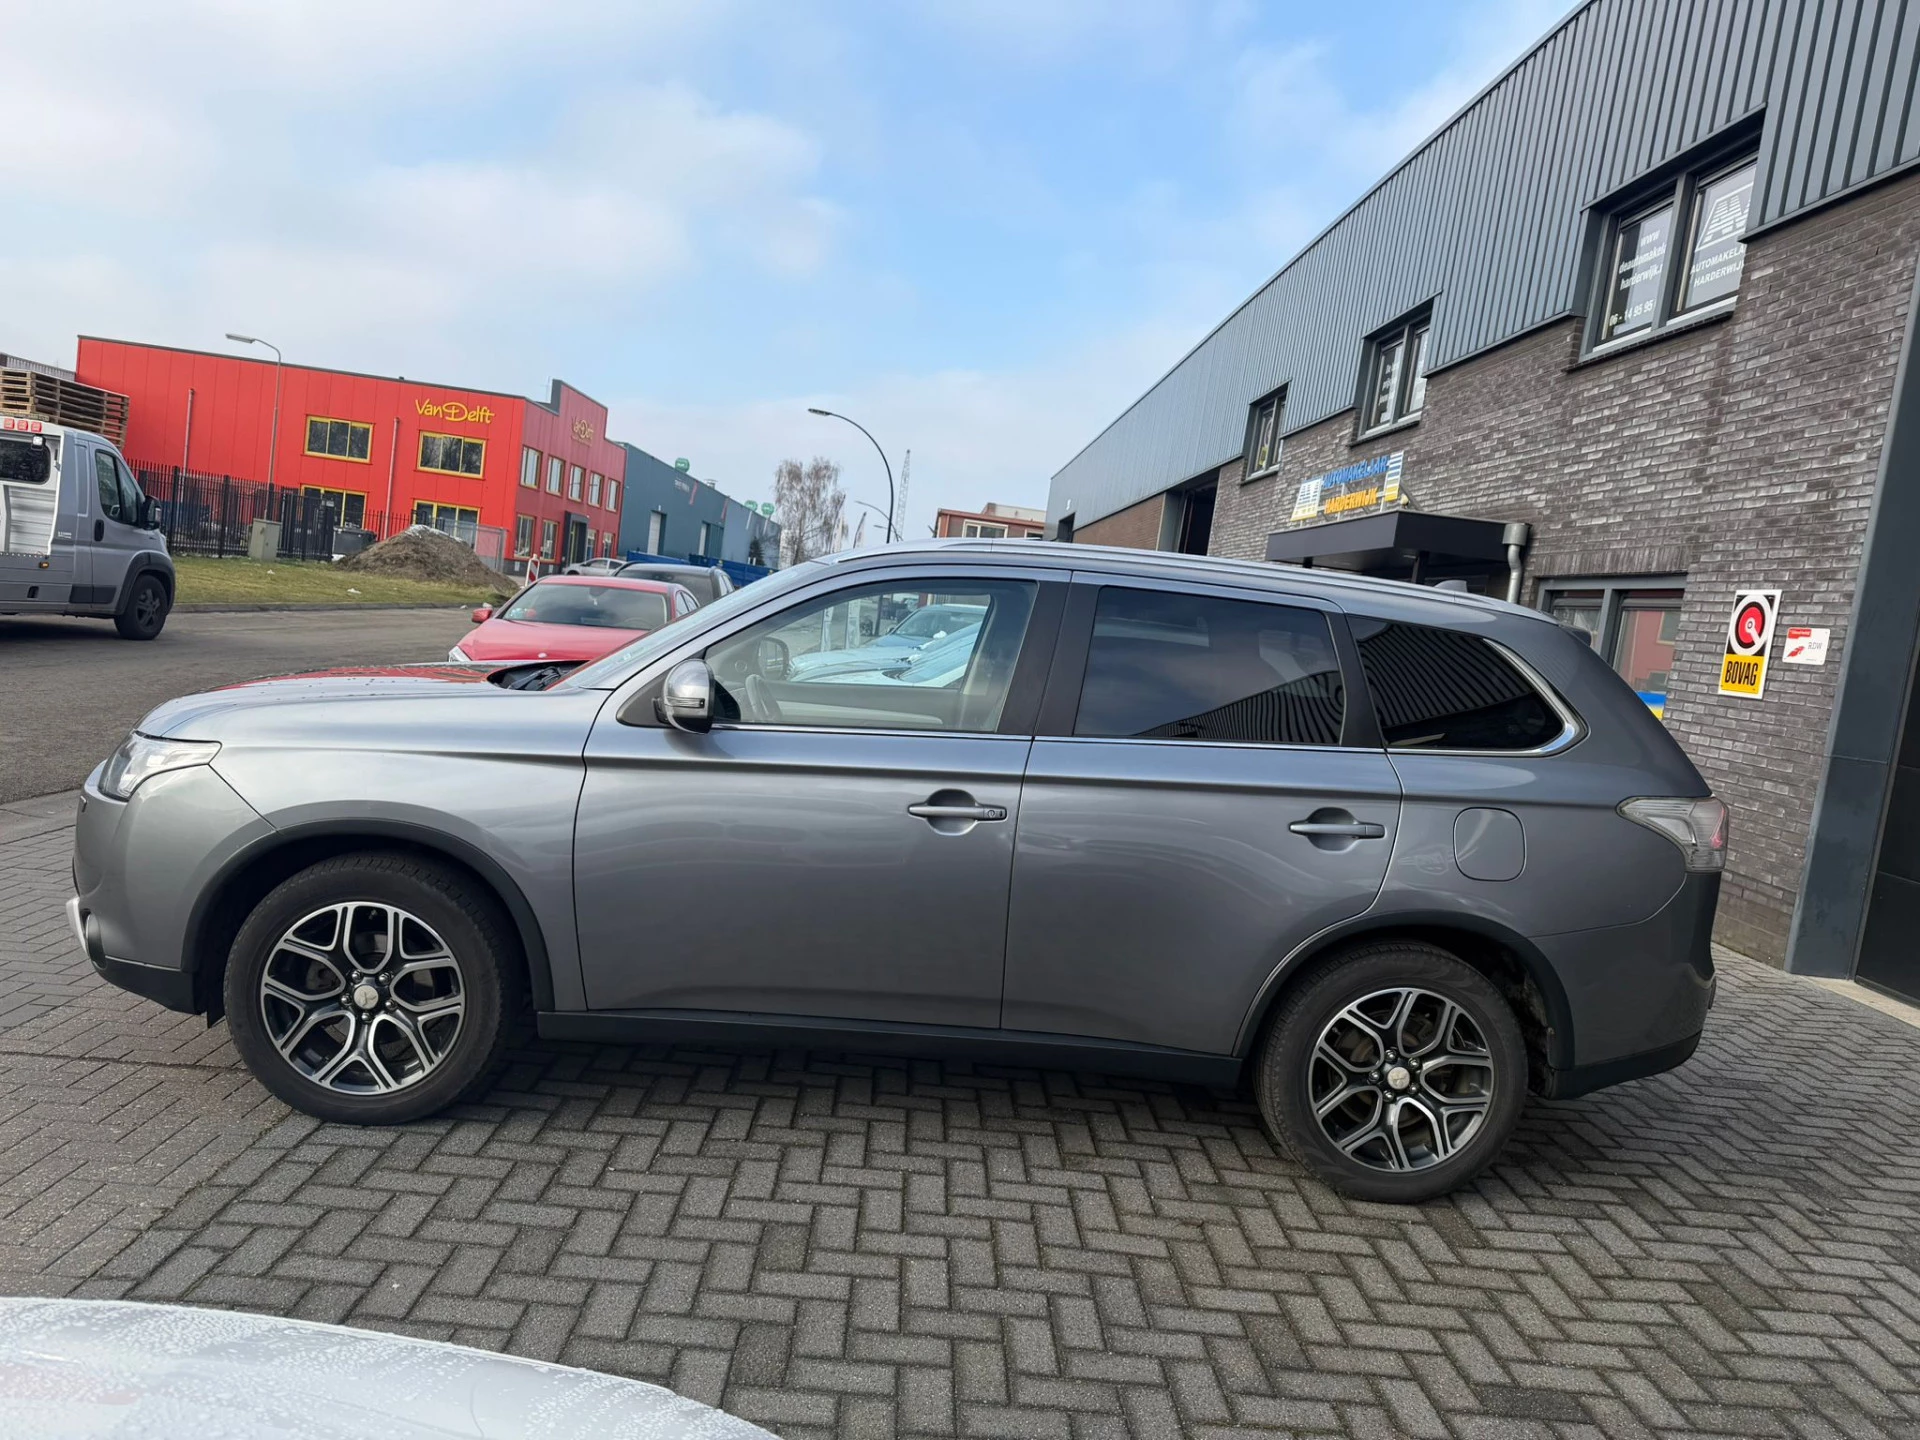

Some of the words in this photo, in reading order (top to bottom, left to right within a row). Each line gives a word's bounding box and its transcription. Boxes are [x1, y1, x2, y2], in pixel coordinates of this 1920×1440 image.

[1690, 244, 1747, 275] AUTOMAKELA
[1324, 487, 1378, 514] HARDERWIJK
[1725, 661, 1759, 686] BOVAG
